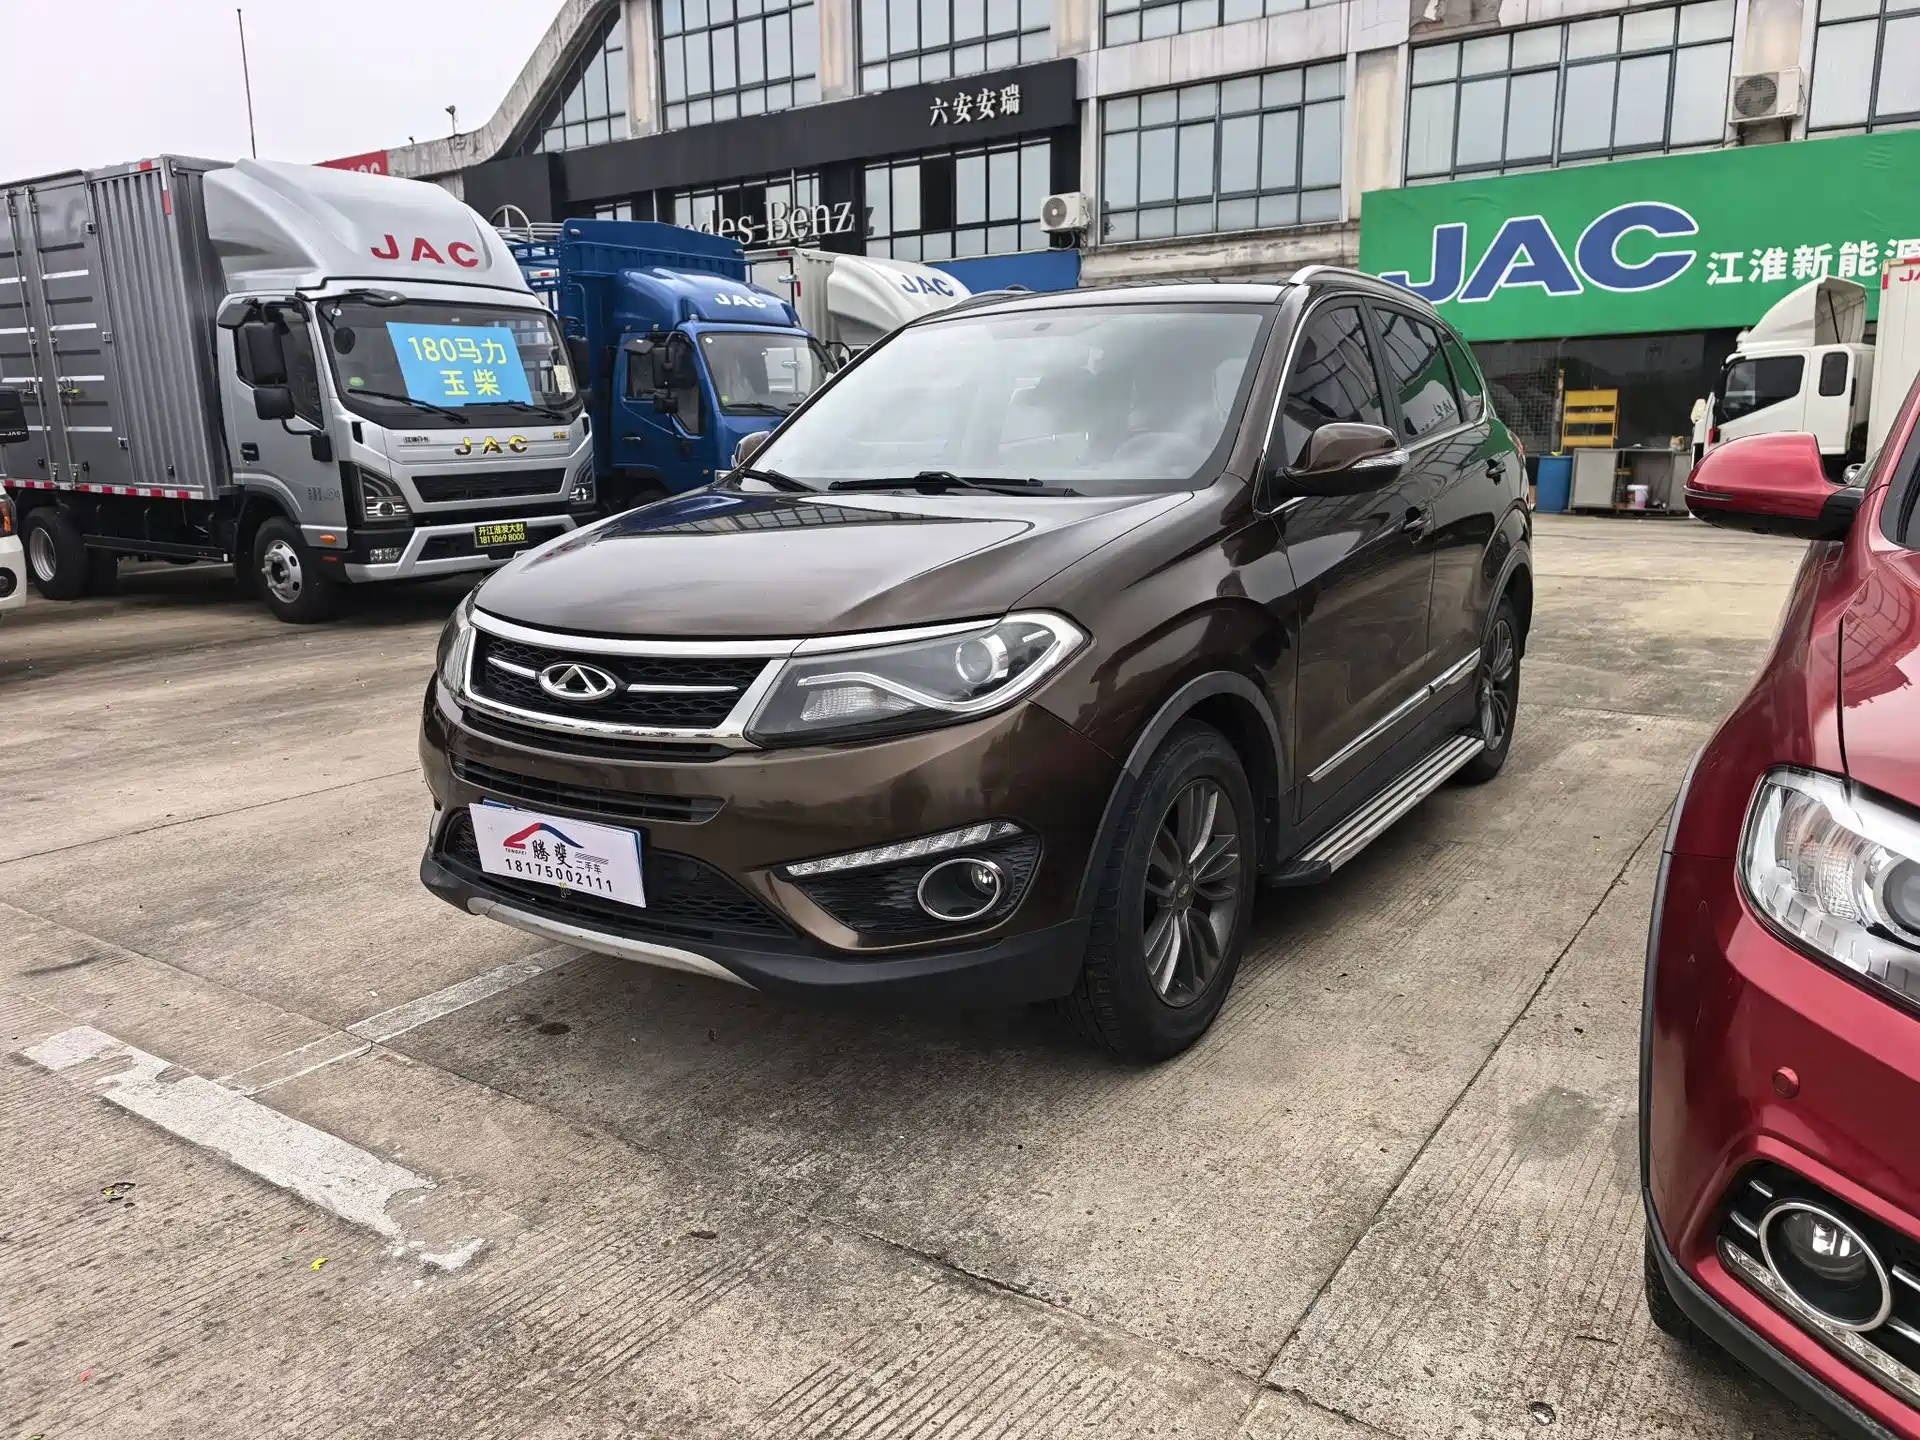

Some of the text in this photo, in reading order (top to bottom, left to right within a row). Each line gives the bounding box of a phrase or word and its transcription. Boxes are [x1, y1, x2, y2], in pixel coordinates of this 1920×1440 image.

[929, 83, 1021, 127] 六安安瑞
[370, 234, 479, 268] JAC
[1378, 202, 1699, 305] JAC
[900, 274, 954, 297] JAC
[714, 292, 767, 308] JAC
[407, 336, 507, 365] 180马力
[440, 368, 501, 396] 玉柴
[454, 434, 529, 456] JAC
[480, 532, 525, 544] 181 1069 8000
[505, 858, 613, 893] 18175002111
[575, 860, 603, 875] 二手车
